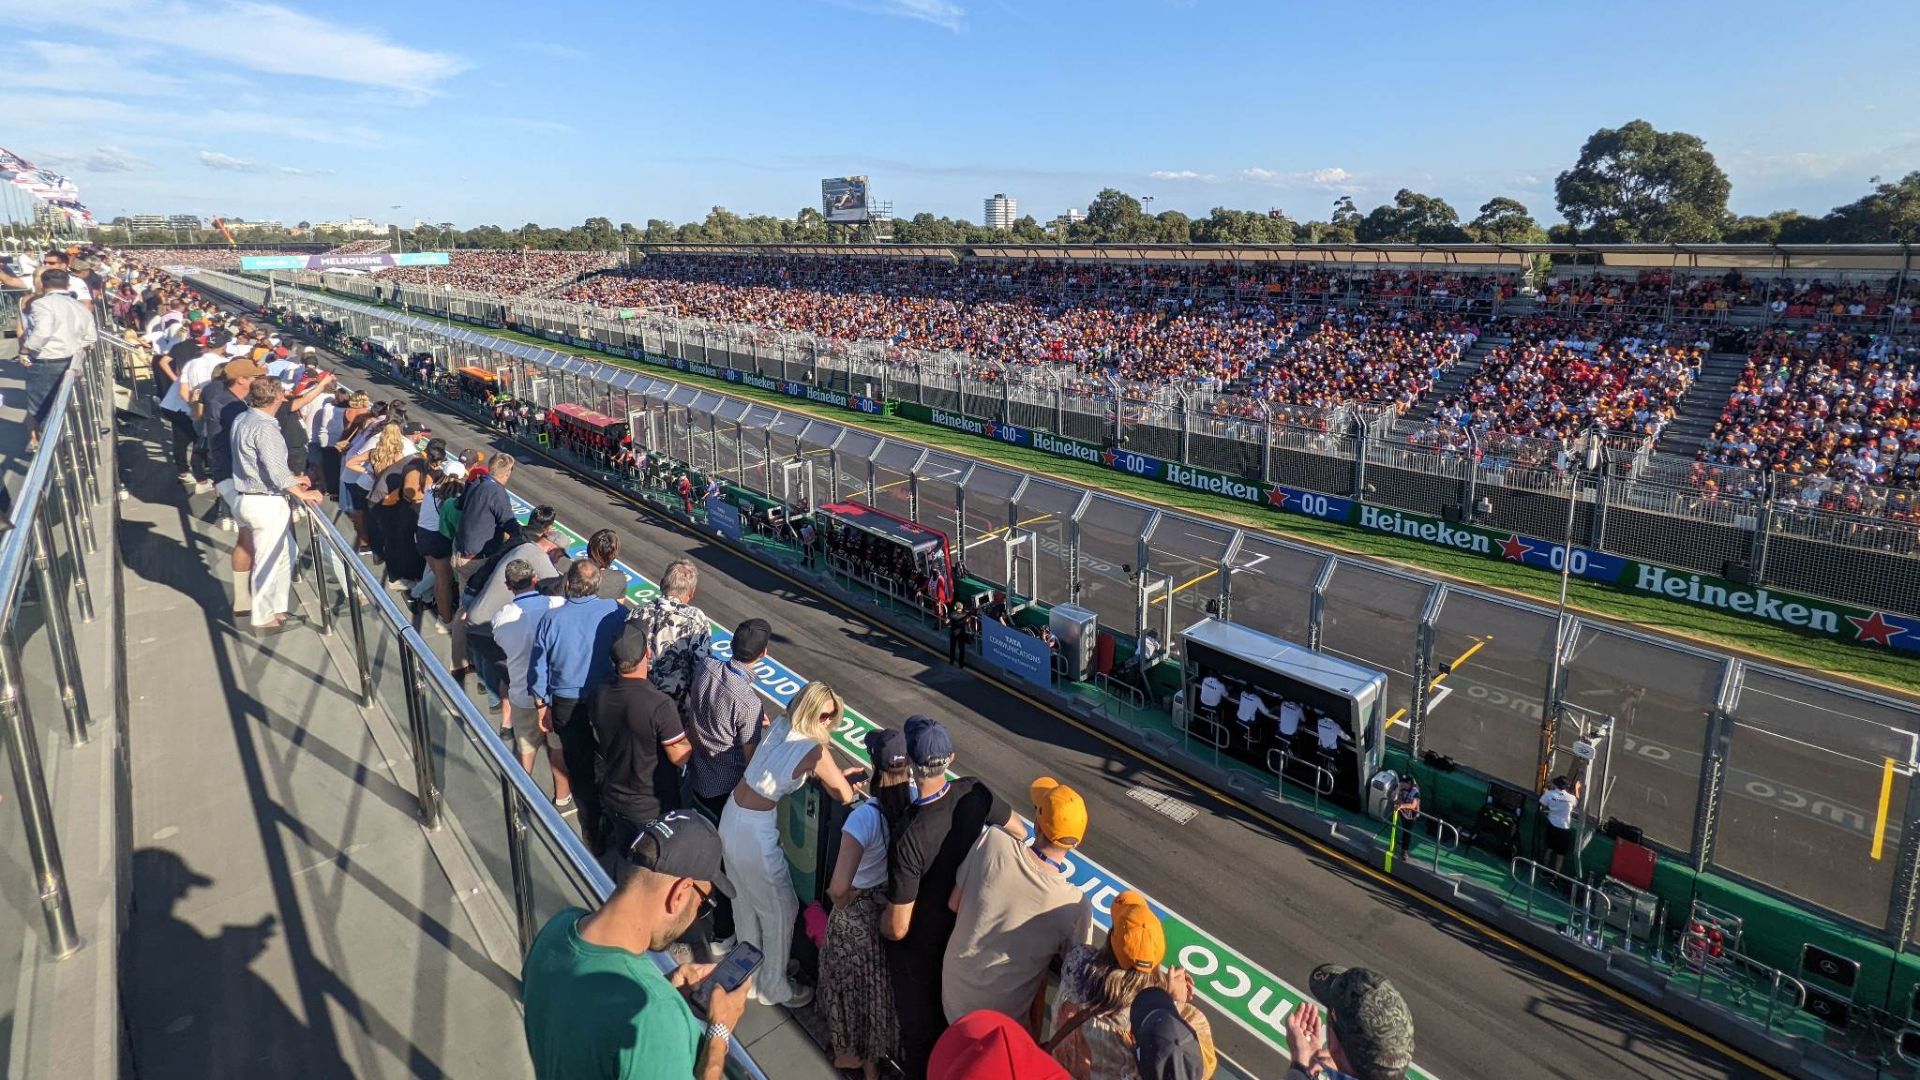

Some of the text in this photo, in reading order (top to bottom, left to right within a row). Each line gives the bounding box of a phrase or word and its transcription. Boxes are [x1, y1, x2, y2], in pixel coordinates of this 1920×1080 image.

[320, 256, 383, 266] MELBOURNE
[742, 373, 776, 391] Heineken
[806, 387, 847, 407] Heineken
[931, 408, 982, 434] Heineken
[1033, 432, 1099, 463] Heineken
[1166, 463, 1259, 502] Heineken
[1301, 494, 1328, 517] 0.0
[1359, 504, 1490, 554] Heineken
[1550, 546, 1588, 574] 00
[1635, 563, 1839, 633] Heineken
[989, 635, 1041, 664] COMMUNICATIONS
[1004, 635, 1022, 648] TATA
[1178, 945, 1294, 1036] mco
